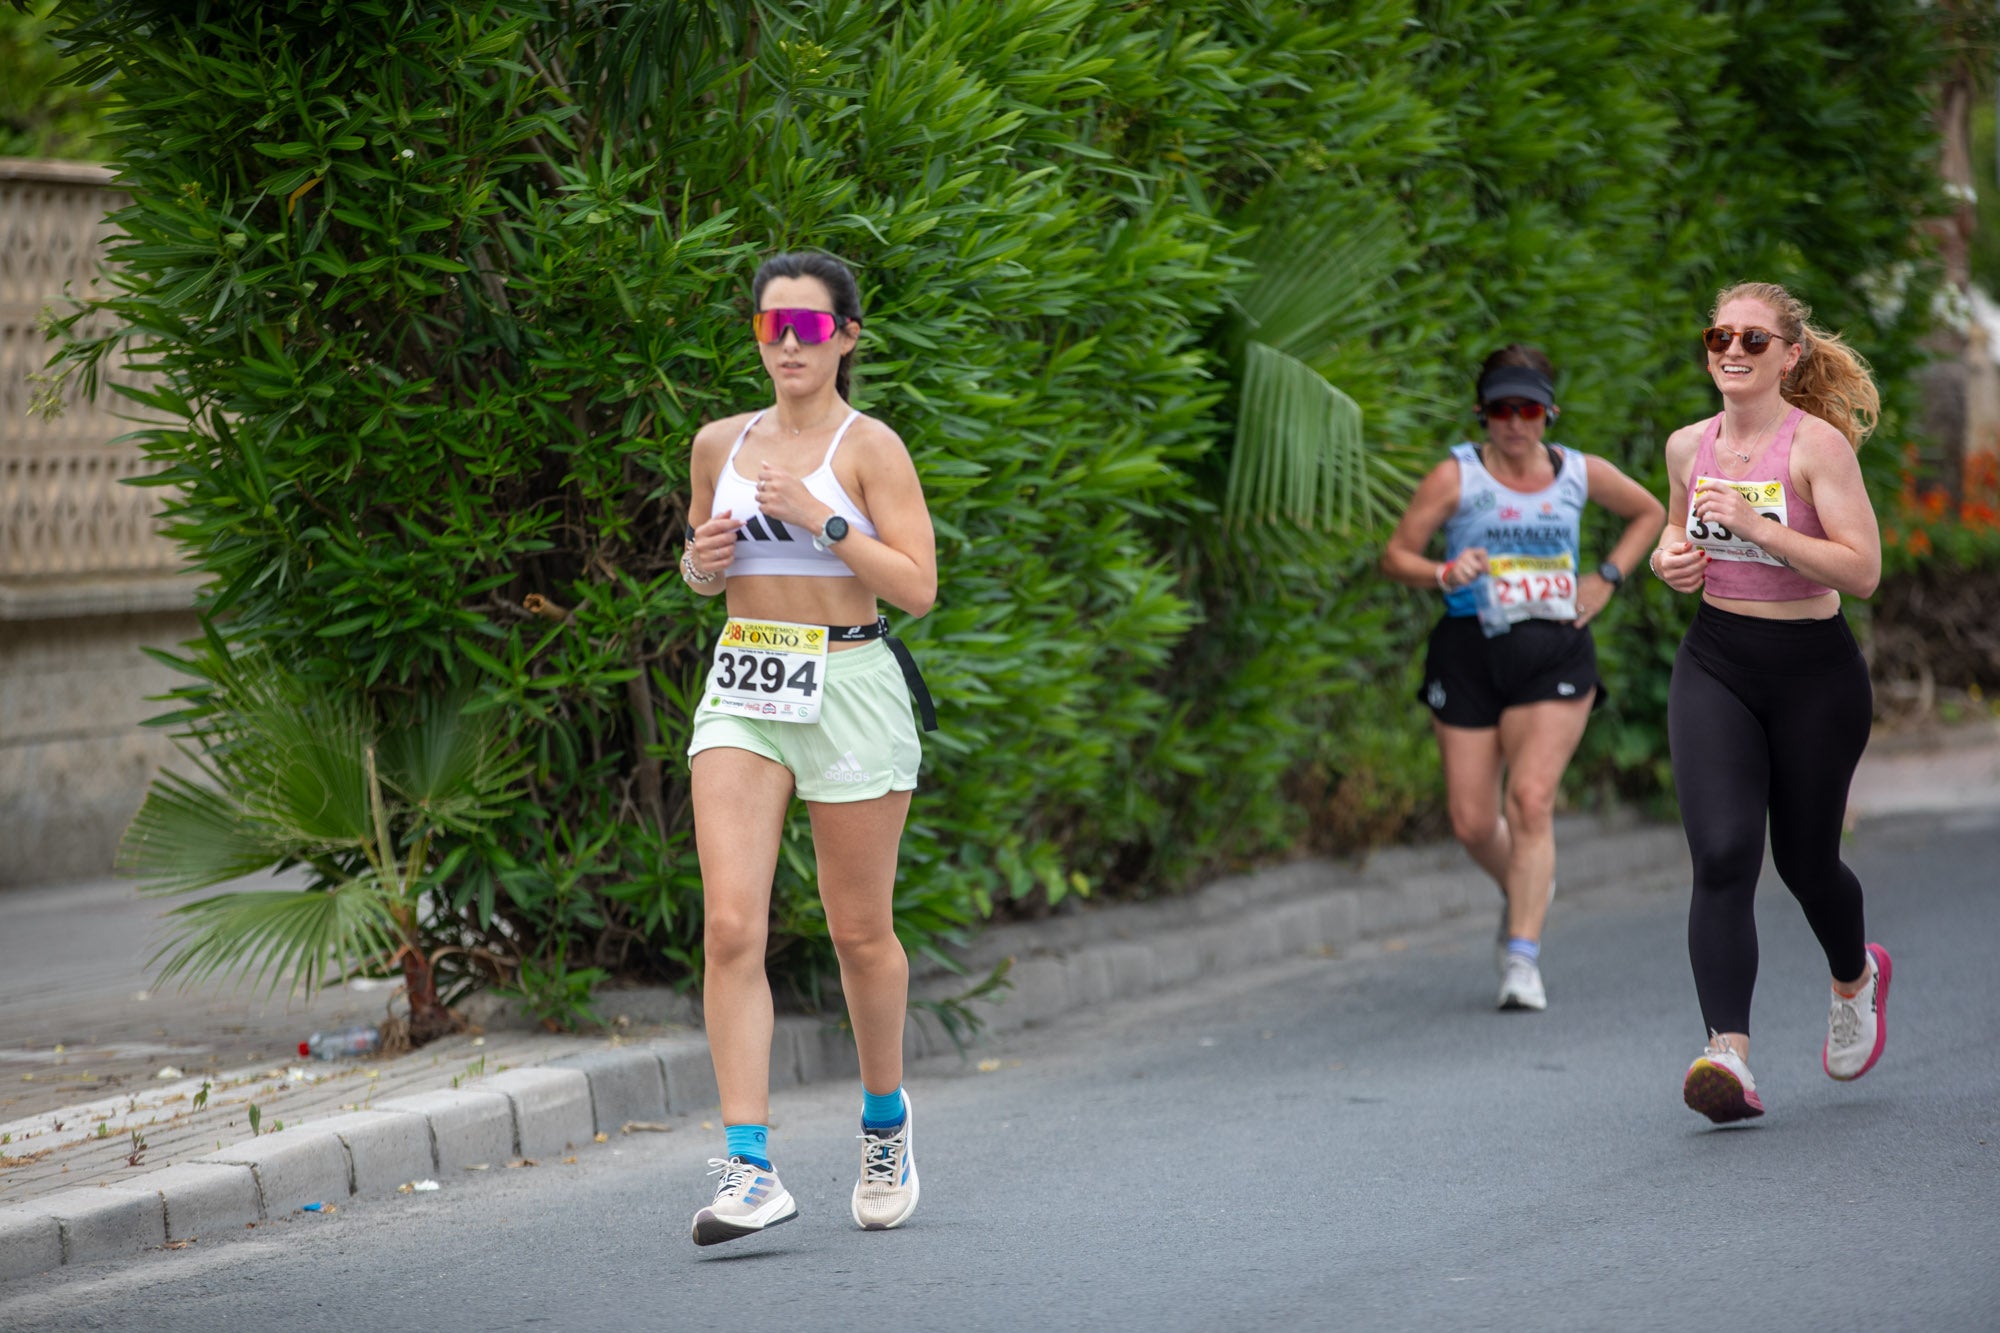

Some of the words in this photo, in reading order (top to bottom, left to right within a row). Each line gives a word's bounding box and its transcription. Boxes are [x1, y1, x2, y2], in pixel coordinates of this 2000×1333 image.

[1496, 574, 1572, 604] 2129
[716, 652, 817, 697] 3294
[825, 769, 870, 783] adidas
